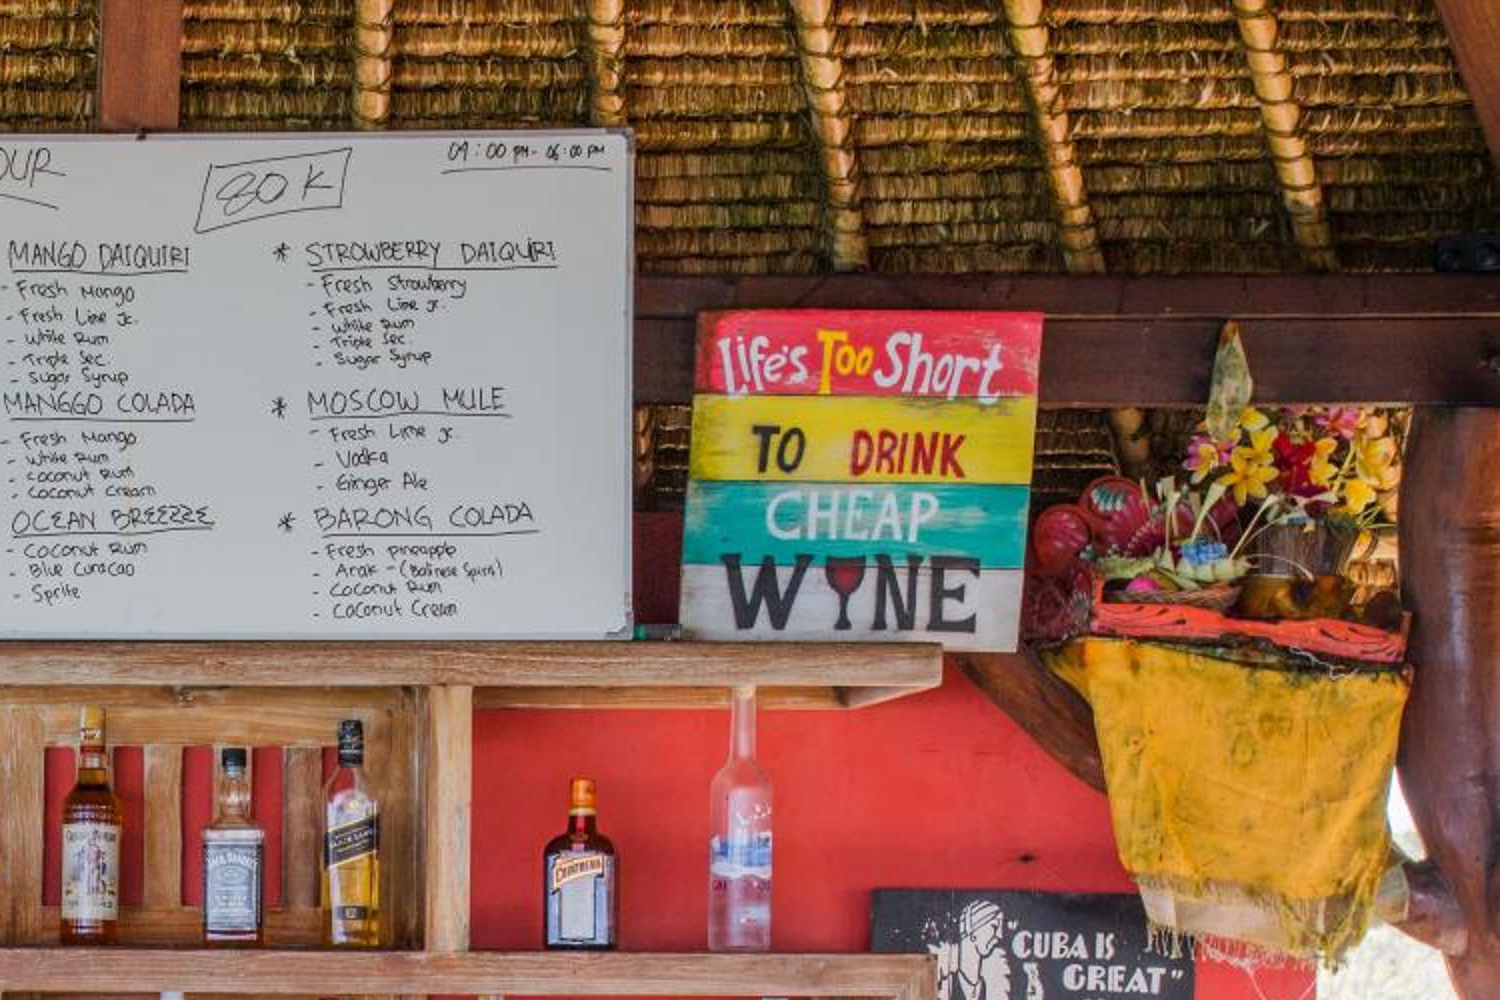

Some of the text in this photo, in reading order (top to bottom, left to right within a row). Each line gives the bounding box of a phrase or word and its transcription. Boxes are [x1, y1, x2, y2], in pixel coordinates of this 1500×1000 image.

[301, 163, 334, 201] K
[8, 240, 190, 269] MANGO DAIQUIRI
[305, 240, 441, 267] STROWBERRY
[16, 279, 135, 307] Fresh Mango
[321, 273, 373, 297] Fresh
[19, 305, 63, 324] Fresh
[322, 296, 373, 317] Fresh
[25, 329, 109, 346] White Rum
[331, 317, 373, 335] White
[333, 349, 432, 370] Sugar Syrup
[718, 329, 1003, 405] Life's Too Short
[29, 368, 129, 390] Sugar Syrup
[3, 391, 196, 415] MANGGO COLADA
[307, 386, 505, 415] MOSCOW MULE
[19, 430, 137, 451] Fresh Mango
[752, 425, 967, 478] TO DRINK
[335, 448, 389, 469] Vodka
[11, 510, 96, 535] OCEAN
[313, 502, 534, 532] BARONG COLADA
[765, 490, 938, 543] CHEAP
[325, 543, 375, 560] Fresh
[28, 561, 63, 578] Blue
[31, 583, 81, 606] Sprite
[1096, 932, 1115, 960] IS
